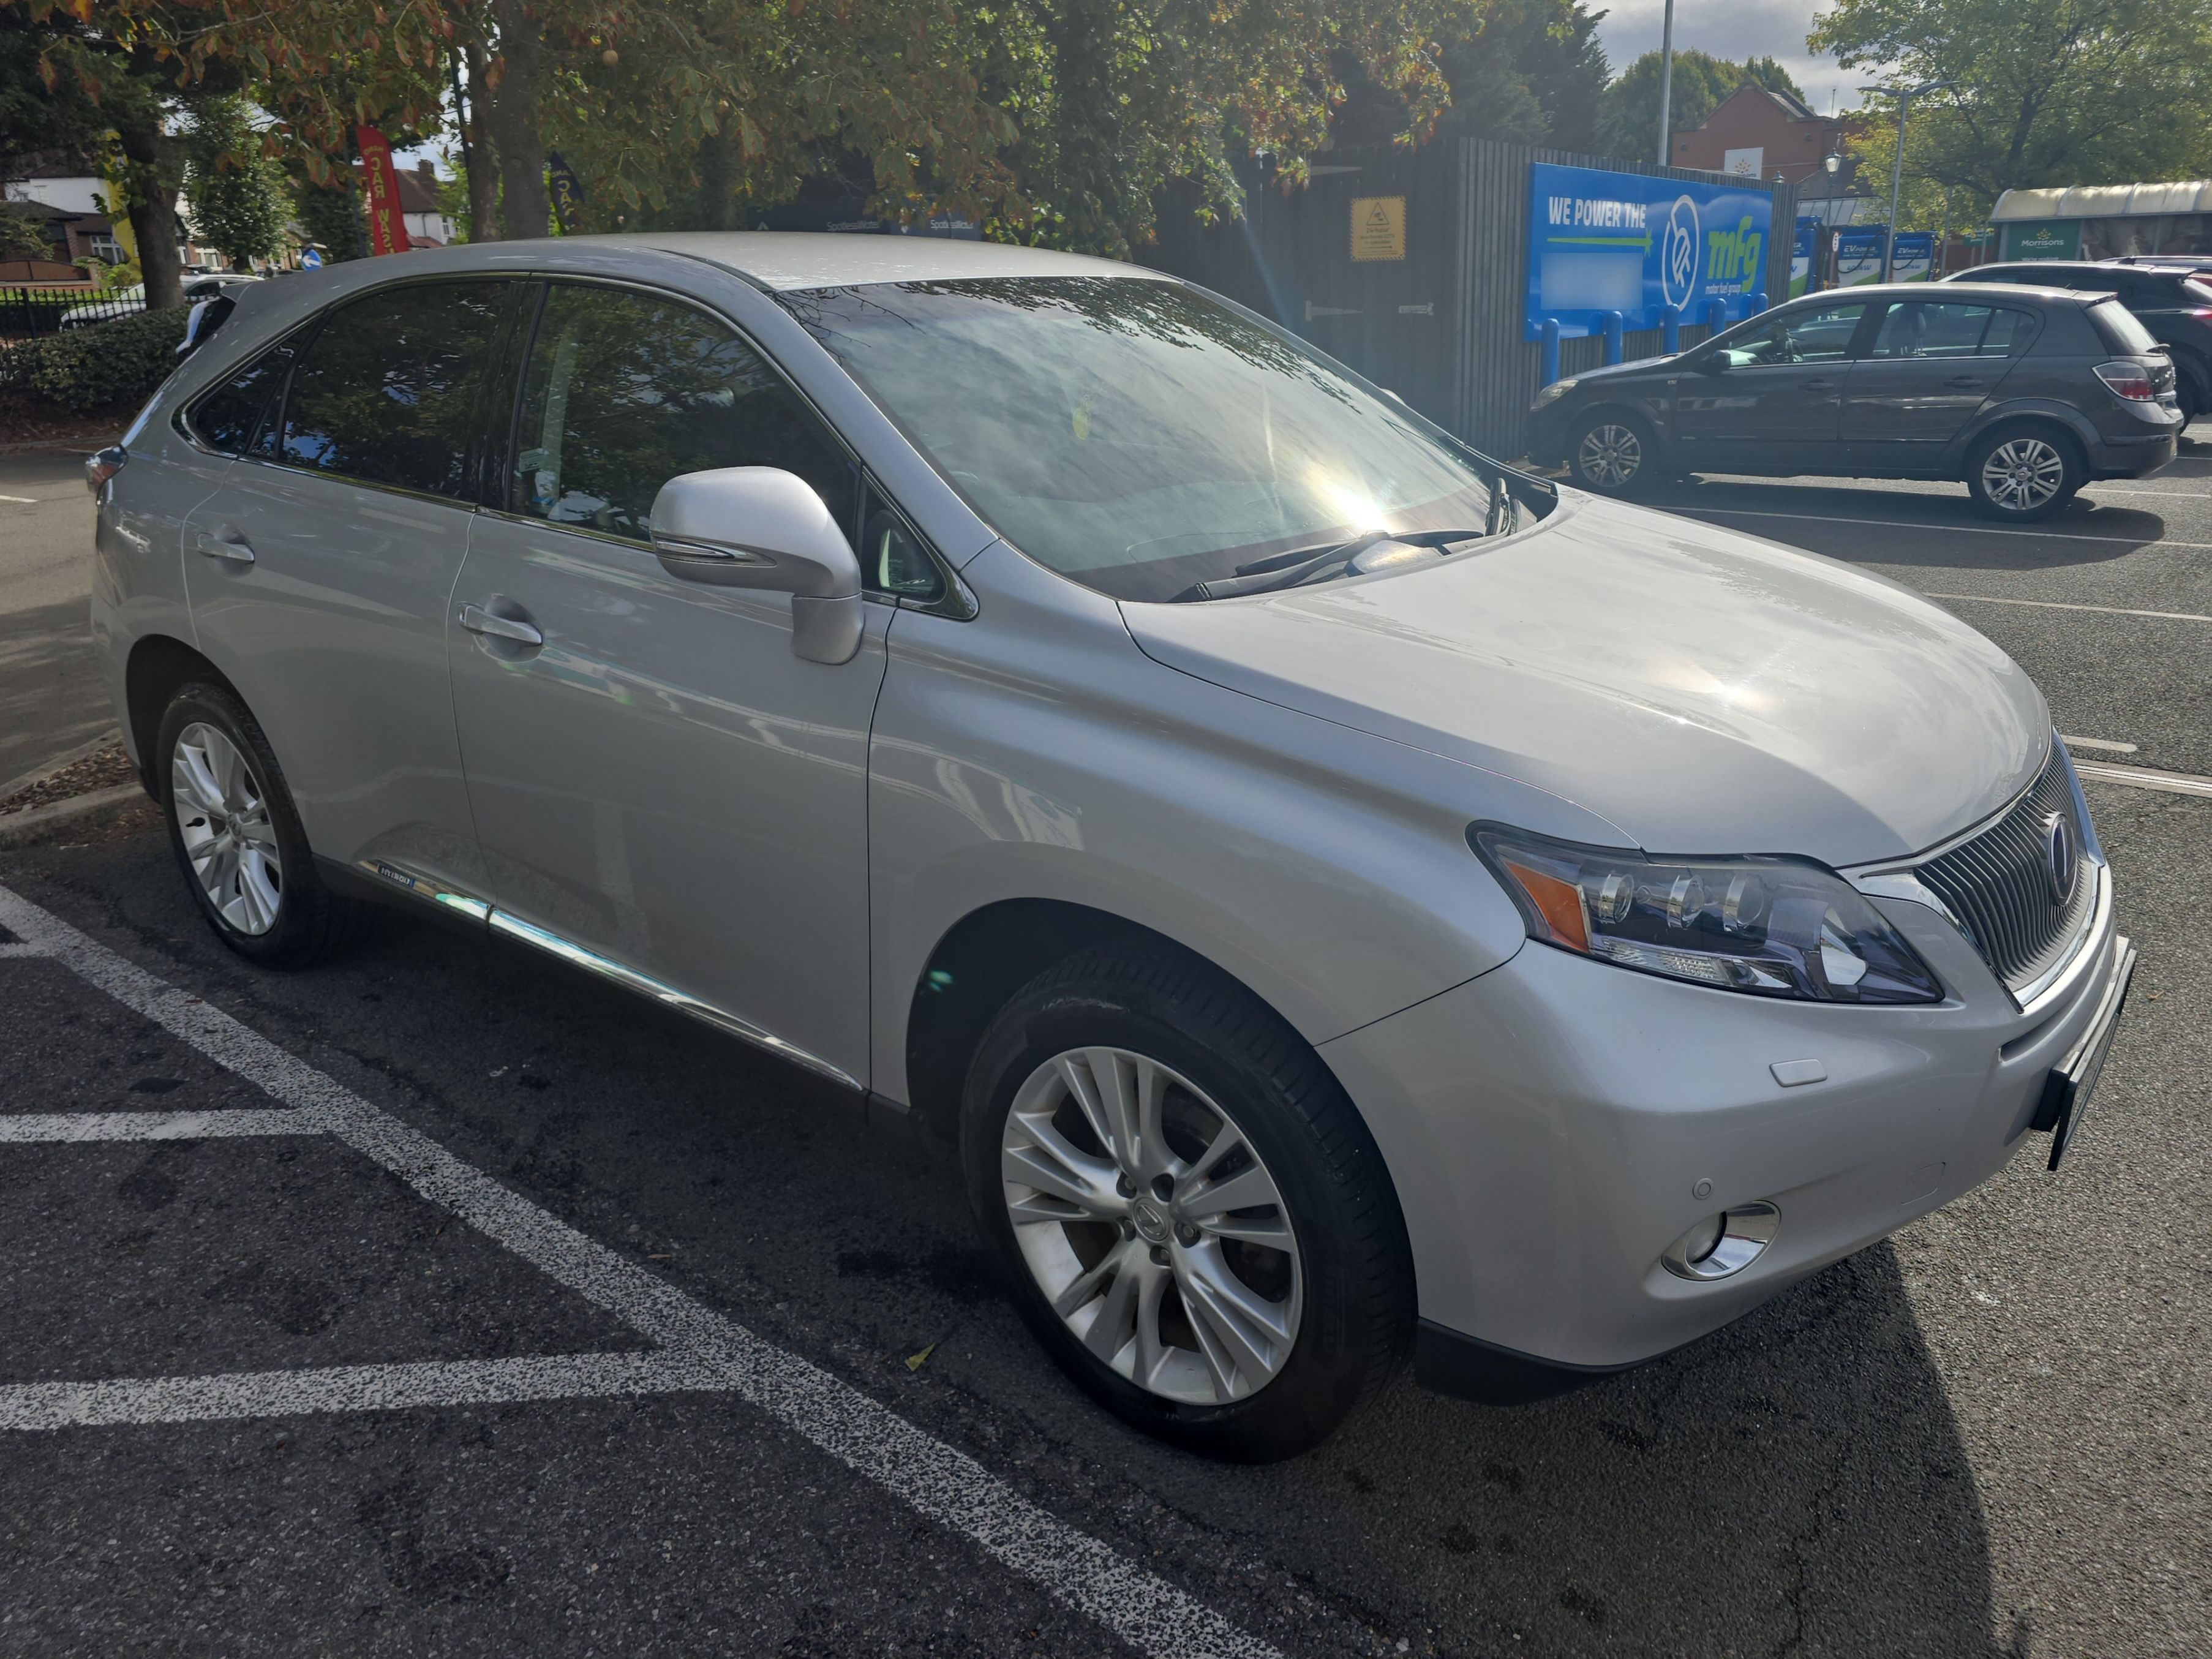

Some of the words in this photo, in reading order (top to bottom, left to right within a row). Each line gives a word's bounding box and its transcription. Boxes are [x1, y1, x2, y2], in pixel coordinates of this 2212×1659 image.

[1549, 197, 1571, 225] WE
[1574, 198, 1620, 228] POWER
[1623, 202, 1647, 229] THE
[1707, 216, 1762, 293] mfg
[1705, 284, 1720, 295] motor
